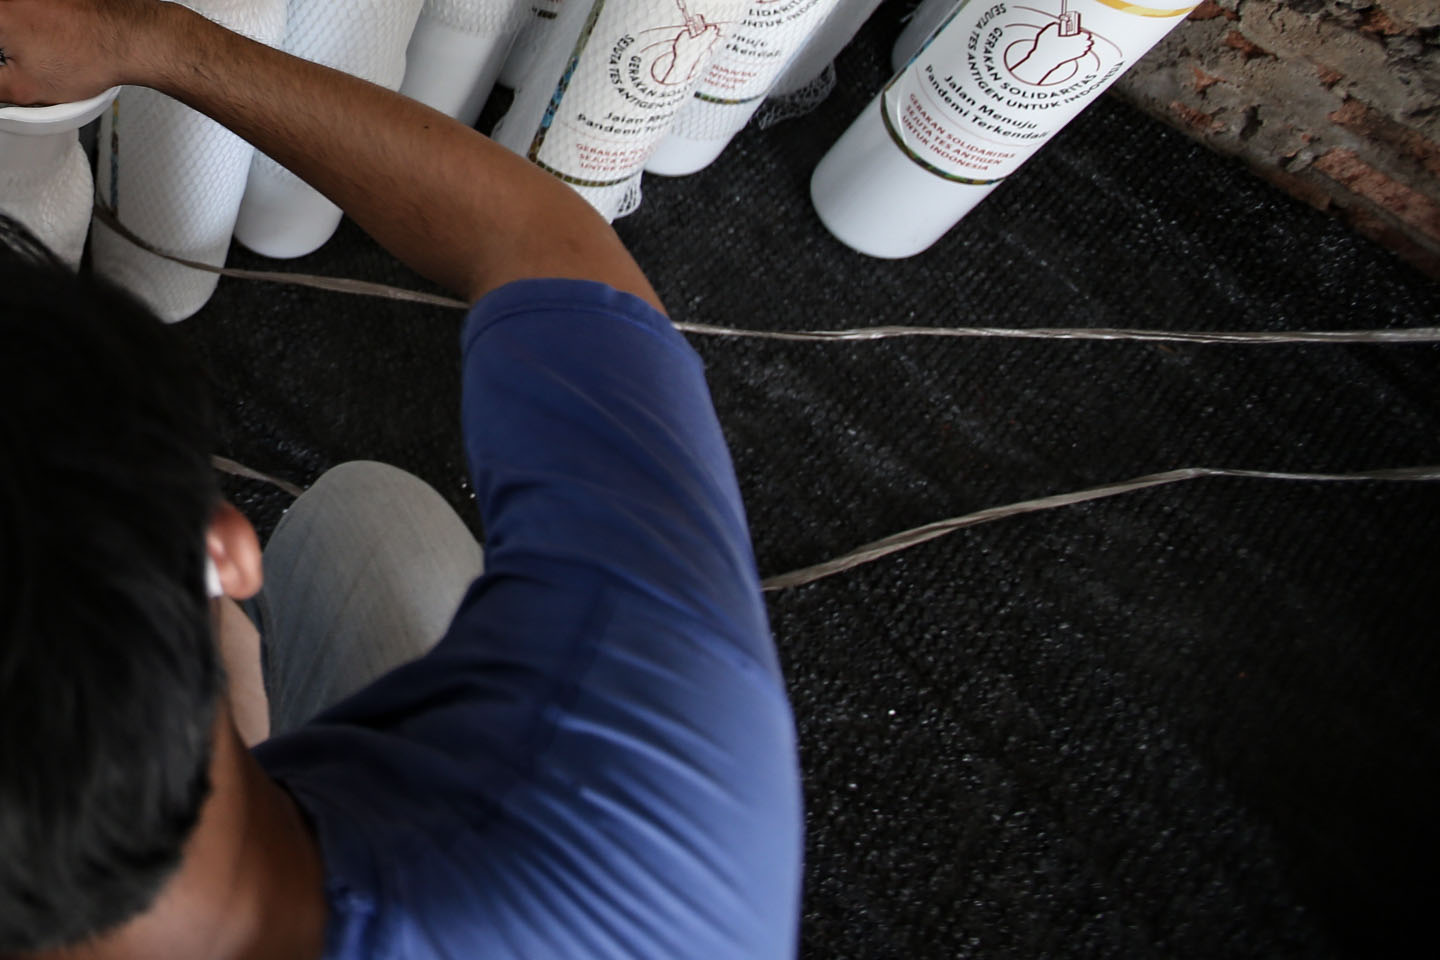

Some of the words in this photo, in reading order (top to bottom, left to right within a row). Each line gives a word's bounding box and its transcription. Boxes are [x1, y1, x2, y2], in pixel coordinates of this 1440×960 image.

[974, 2, 1007, 29] SEJUTA
[609, 34, 634, 65] SEJUTA
[968, 30, 980, 51] TES
[609, 67, 622, 86] TES
[629, 55, 658, 98] GERAKAN
[967, 52, 1004, 103] ANTIGEN
[983, 26, 1003, 82] GERAKAN
[1000, 73, 1097, 100] SOLIDARITAS
[924, 64, 969, 118] Pandemi
[943, 74, 977, 107] Jalan
[978, 104, 1038, 130] Menuju
[1006, 100, 1061, 111] UNTUK
[902, 115, 929, 146] UNTUK
[905, 104, 935, 138] SEJUTA
[934, 135, 951, 151] TES
[953, 147, 1003, 166] ANTIGEN
[909, 93, 945, 135] GERAKAN
